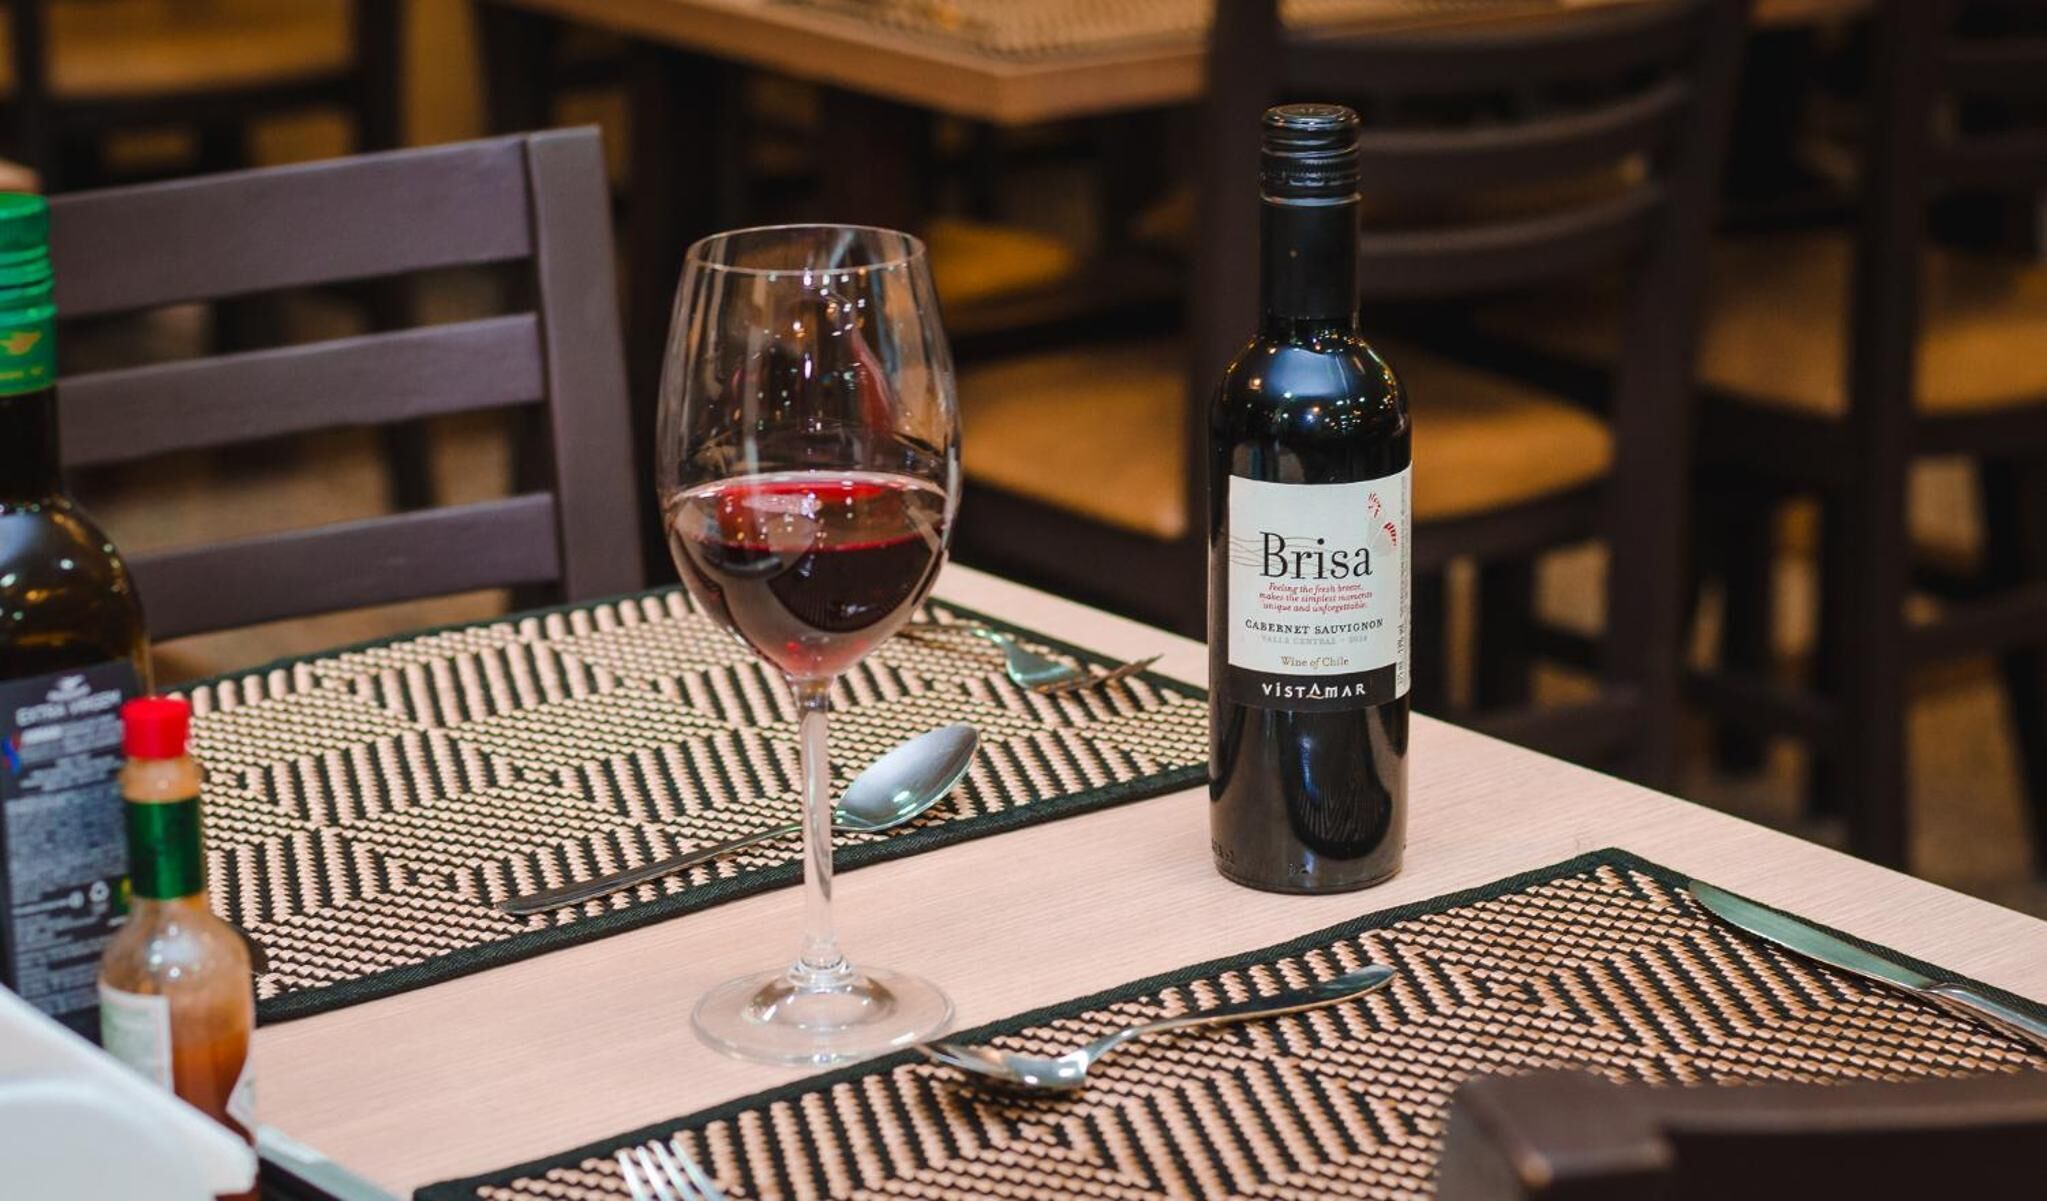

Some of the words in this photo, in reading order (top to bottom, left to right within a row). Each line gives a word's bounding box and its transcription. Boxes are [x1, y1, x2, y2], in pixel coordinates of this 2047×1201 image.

[1259, 531, 1373, 580] Brisa
[1268, 582, 1298, 595] Feeling
[1300, 583, 1313, 593] the
[1314, 583, 1337, 596] fresh
[1259, 592, 1284, 601] makes
[1285, 592, 1299, 602] the
[1300, 592, 1337, 604] simplest
[1338, 591, 1373, 602] moments
[1263, 602, 1291, 613] unique
[1293, 602, 1312, 612] and
[1245, 618, 1311, 635] CABERNET
[1314, 618, 1384, 635] SAUVIGNON
[1281, 655, 1307, 667] Wine
[1309, 656, 1321, 669] of
[1321, 655, 1349, 667] Chile
